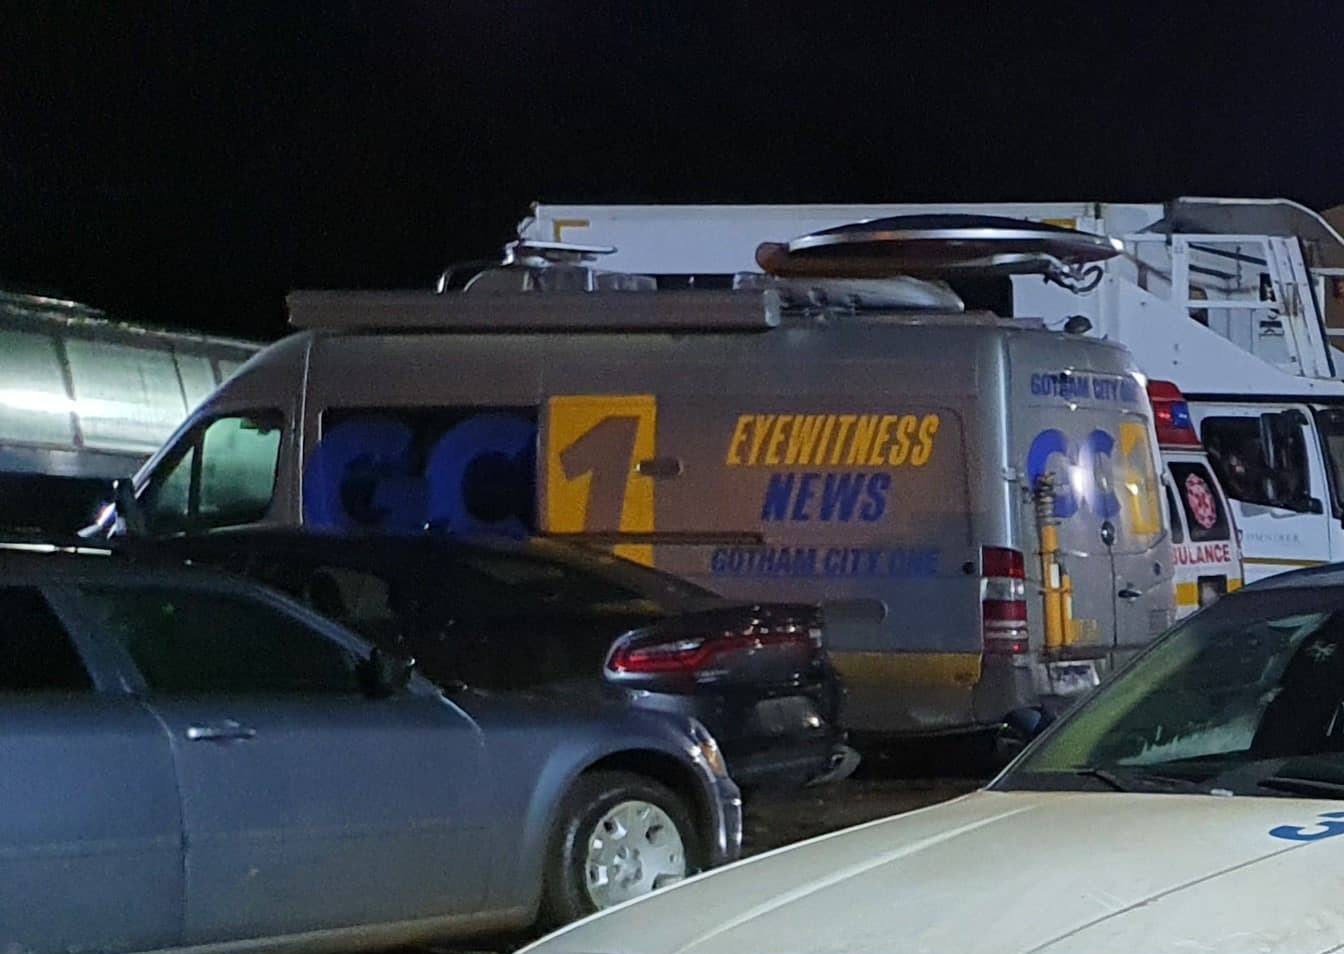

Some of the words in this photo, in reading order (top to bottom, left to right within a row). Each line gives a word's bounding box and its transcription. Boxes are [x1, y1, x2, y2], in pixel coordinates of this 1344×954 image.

[726, 413, 940, 467] EYEWITNESS
[761, 471, 892, 523] NEWS
[711, 547, 815, 578] GOTHAM
[822, 547, 886, 578] CITY
